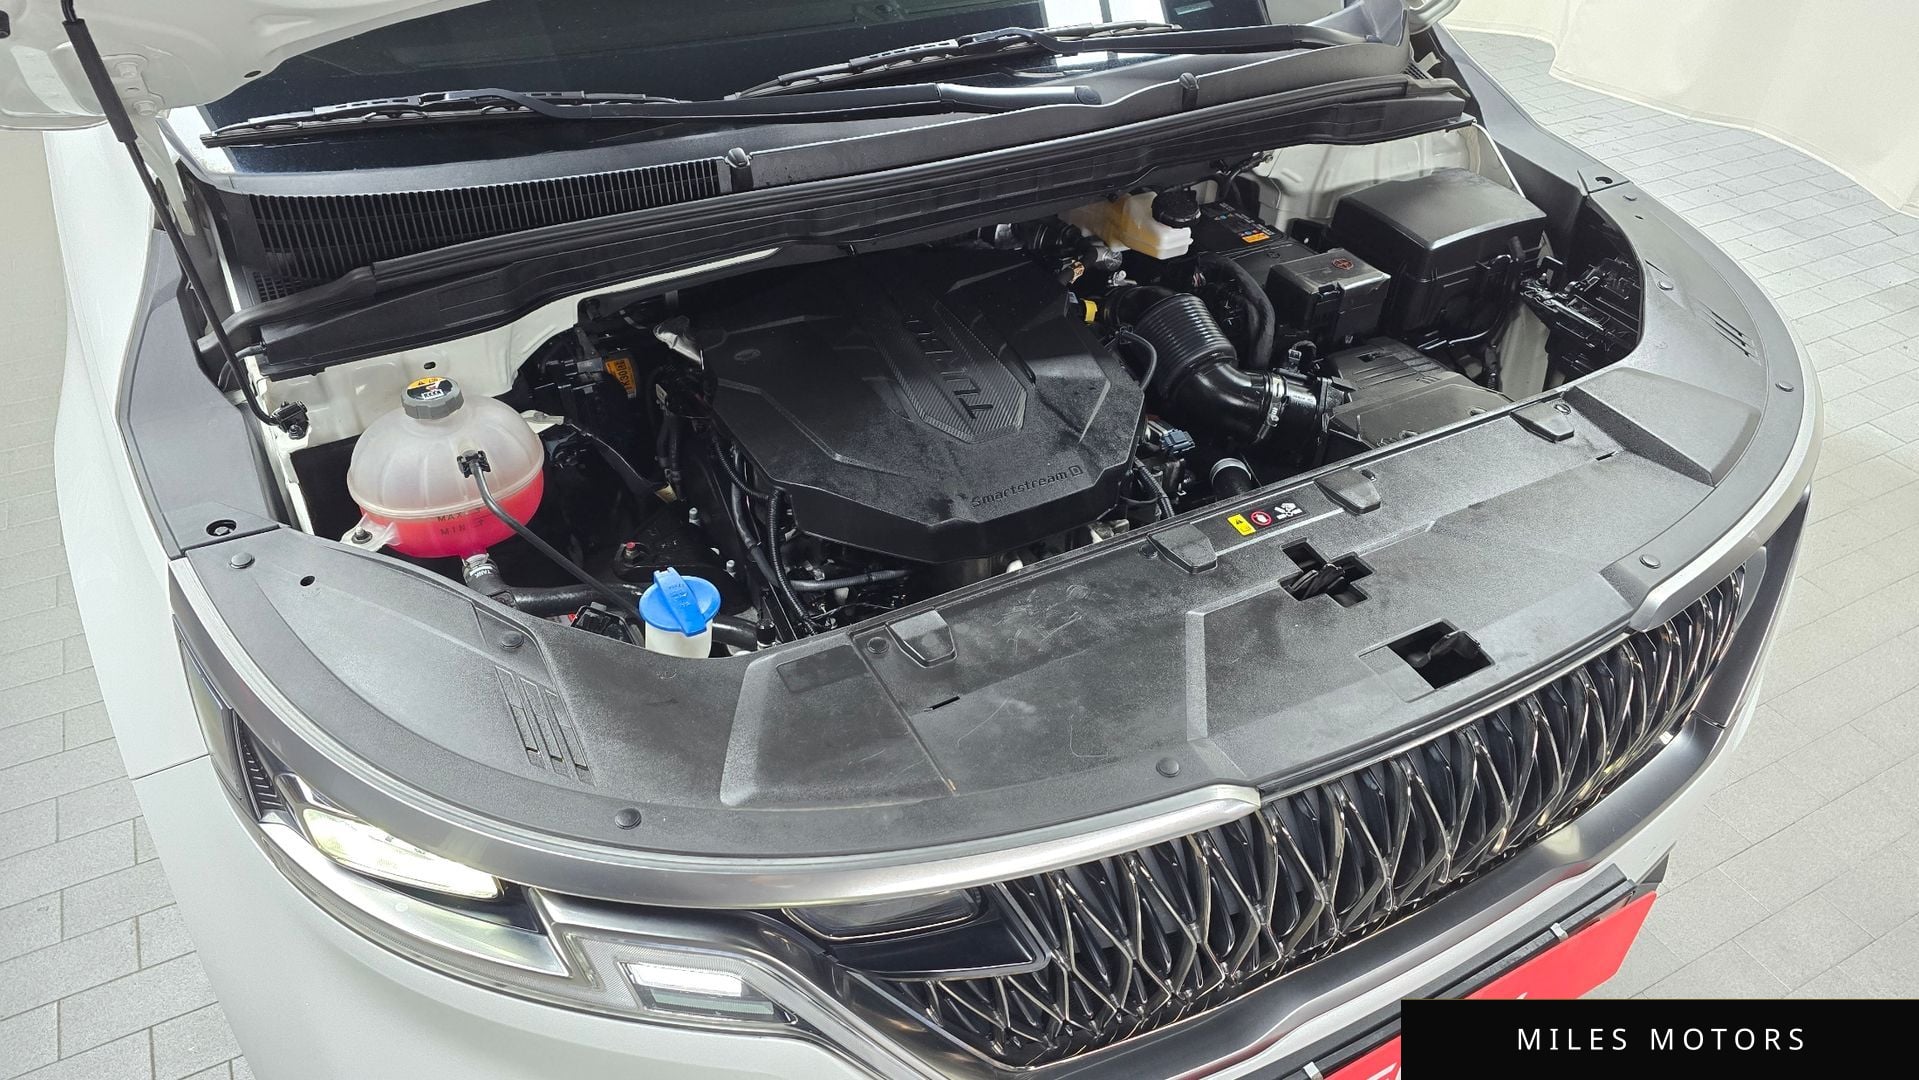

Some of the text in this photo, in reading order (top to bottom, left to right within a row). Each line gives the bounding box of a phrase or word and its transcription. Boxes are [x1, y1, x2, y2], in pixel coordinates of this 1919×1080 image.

[971, 472, 1068, 508] Smartstream
[437, 512, 462, 522] MAX
[440, 525, 466, 535] MIN
